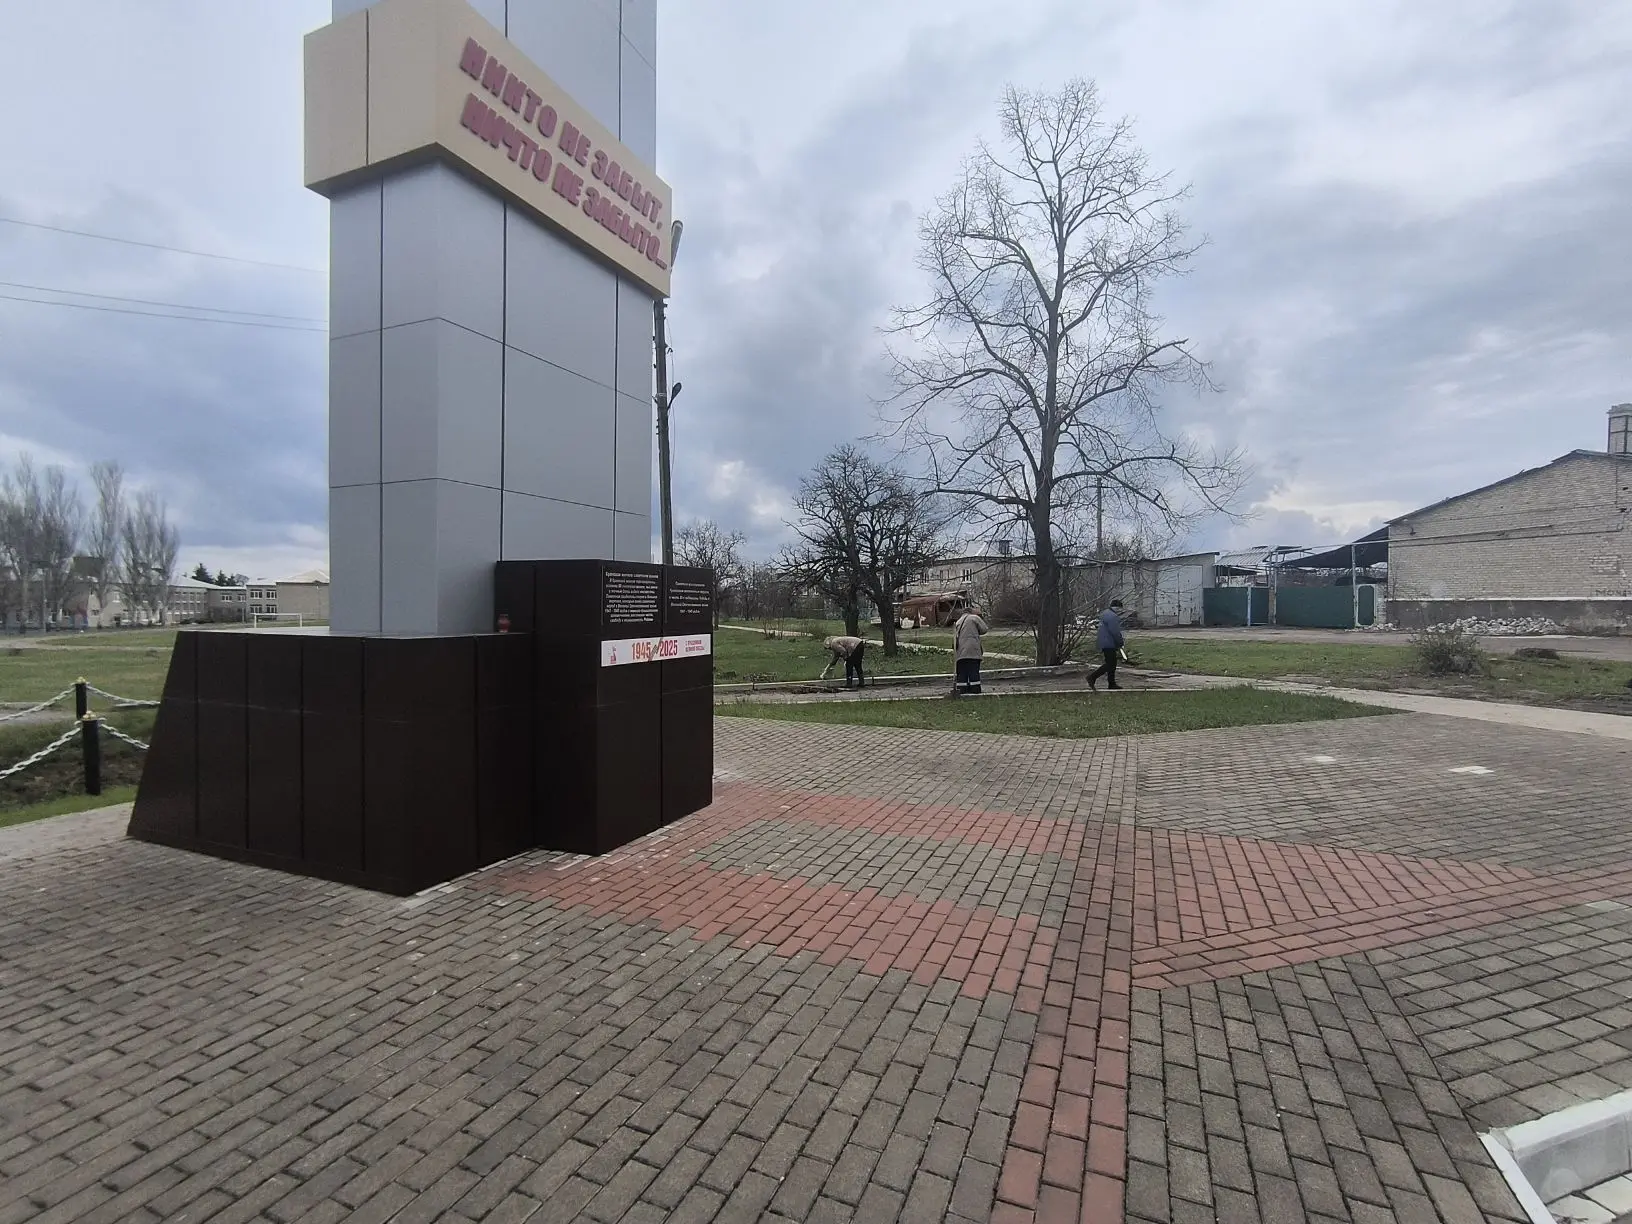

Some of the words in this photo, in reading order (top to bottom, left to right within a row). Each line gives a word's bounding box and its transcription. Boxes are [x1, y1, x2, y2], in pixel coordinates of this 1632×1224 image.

[460, 36, 558, 138] НИКТО
[559, 121, 592, 168] НЕ
[591, 150, 663, 230] ЗАБЫТ,
[460, 93, 553, 183] НИЧТО
[551, 162, 584, 207] НЕ
[632, 641, 652, 661] 1945
[659, 640, 678, 657] 2025
